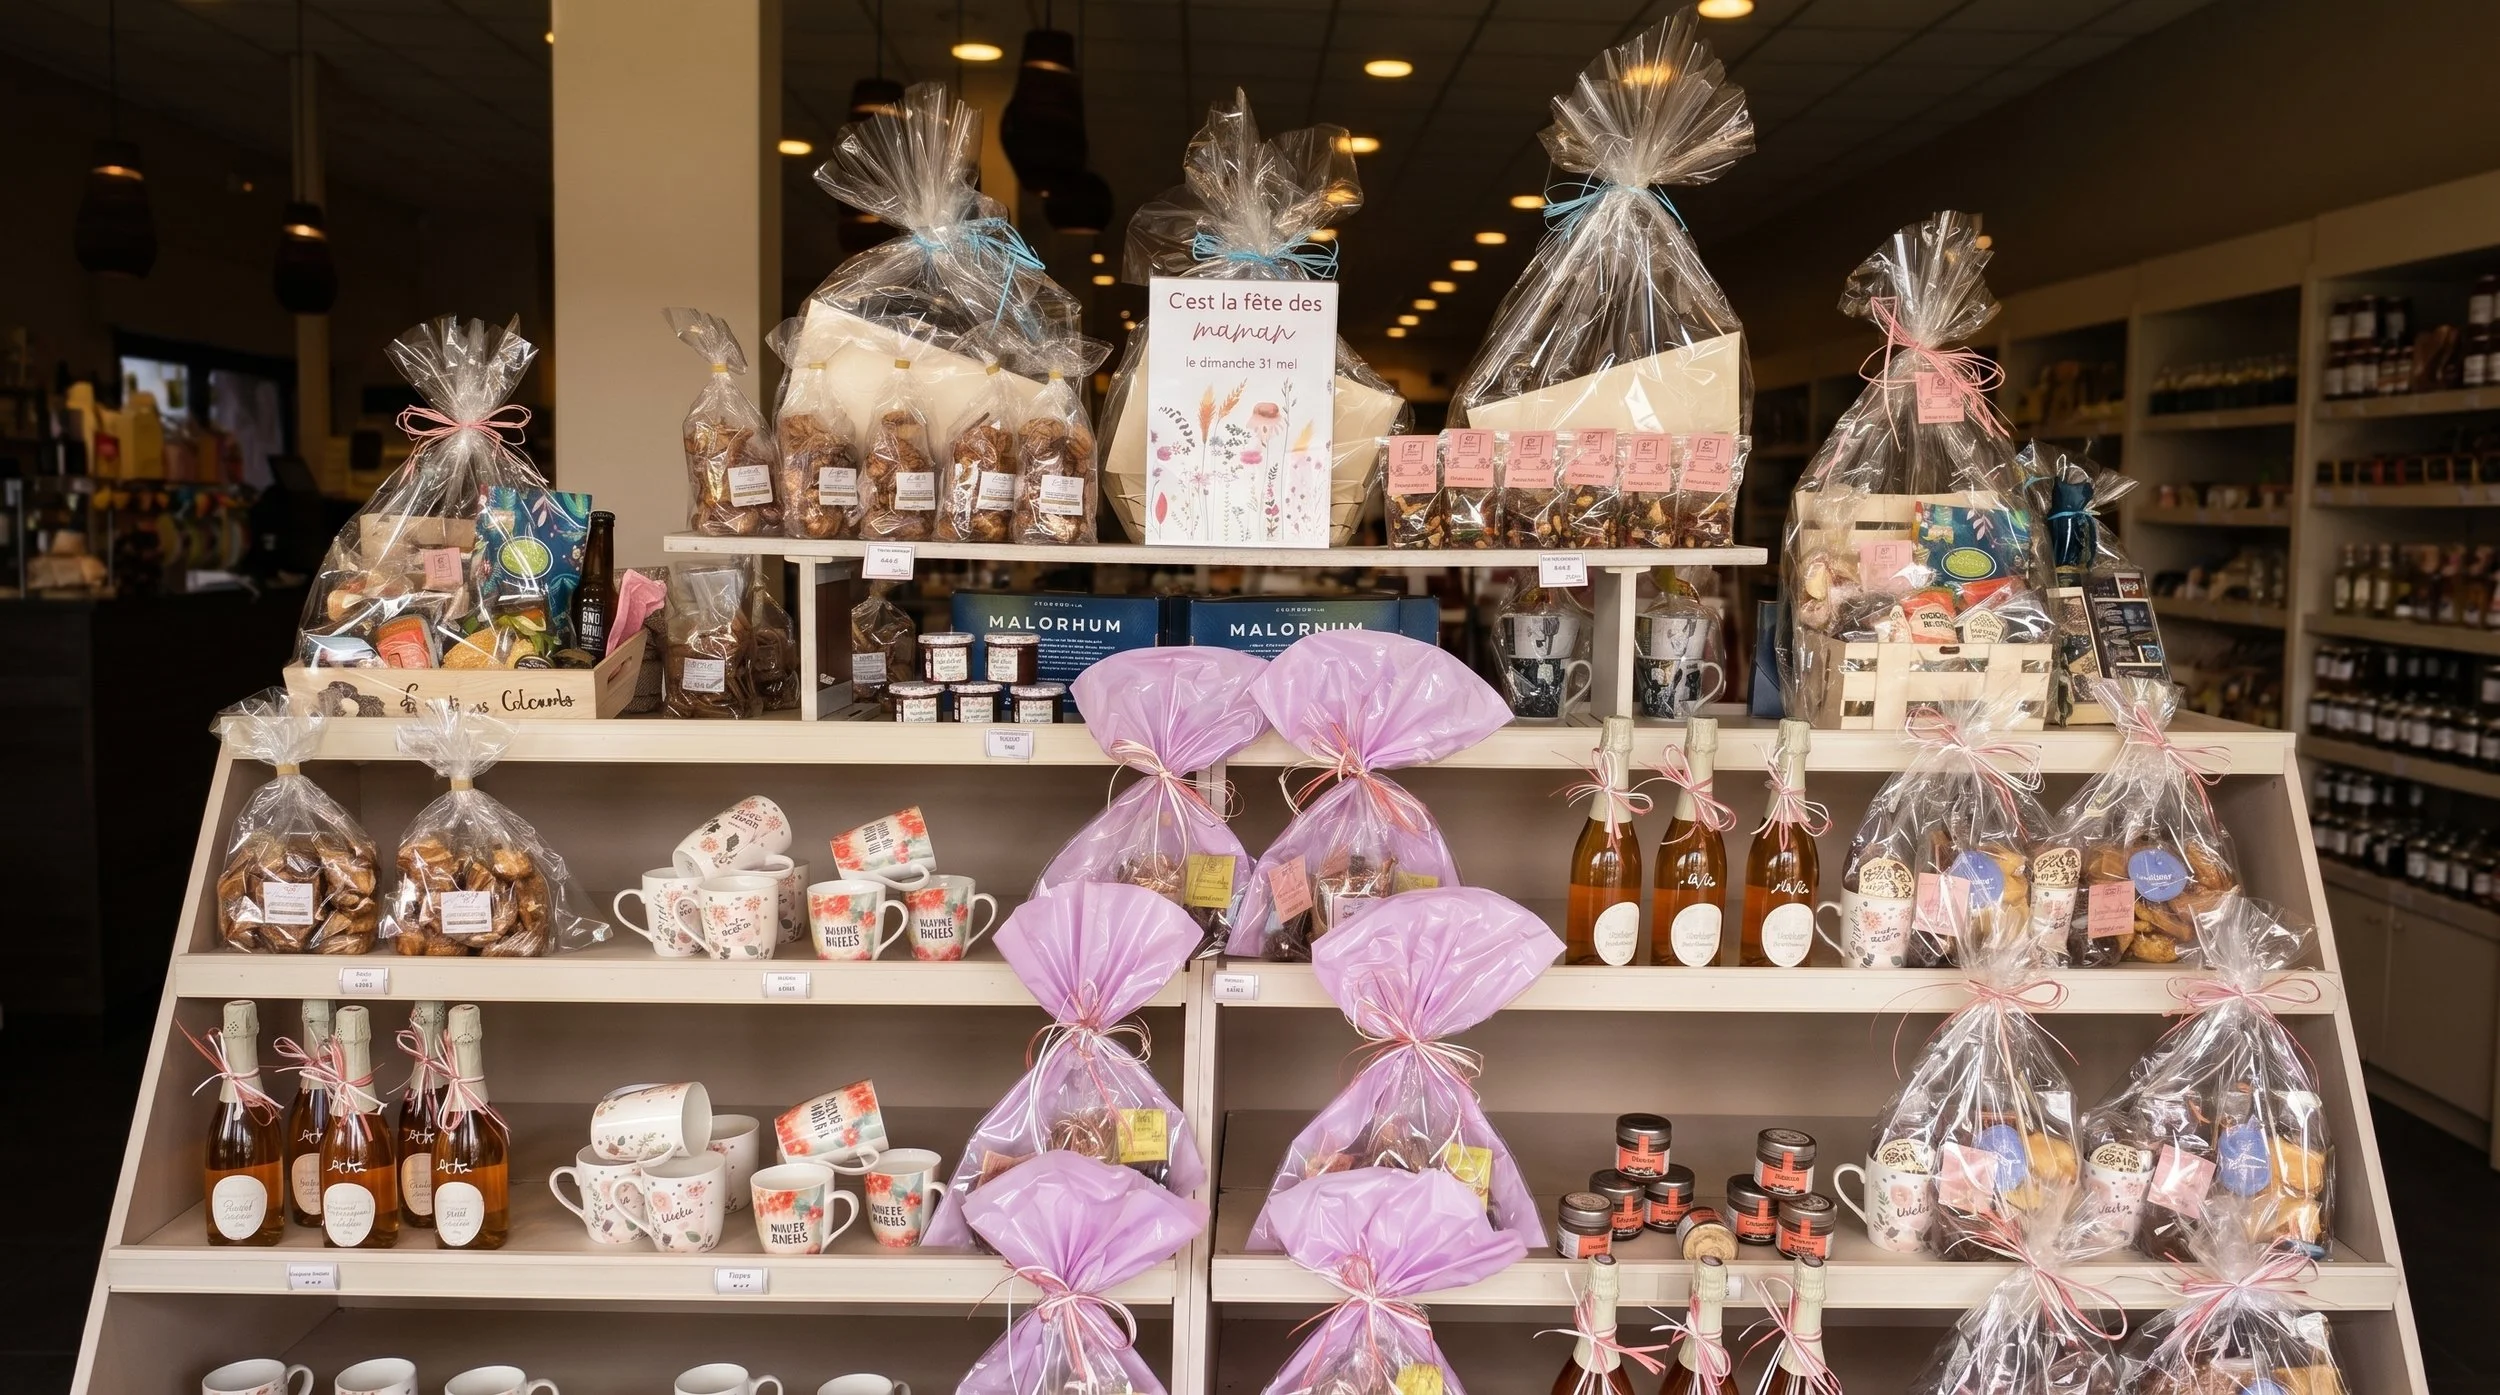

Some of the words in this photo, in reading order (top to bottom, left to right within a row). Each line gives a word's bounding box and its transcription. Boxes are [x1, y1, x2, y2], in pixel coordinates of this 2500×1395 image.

[1169, 292, 1215, 310] C'est
[1222, 292, 1237, 310] la
[1243, 292, 1283, 311] fête
[1289, 293, 1322, 312] des
[1192, 322, 1296, 344] maman
[1185, 356, 1196, 368] le
[1199, 356, 1256, 369] dimanche
[1259, 358, 1272, 369] 31
[989, 615, 1121, 633] MALORHUM
